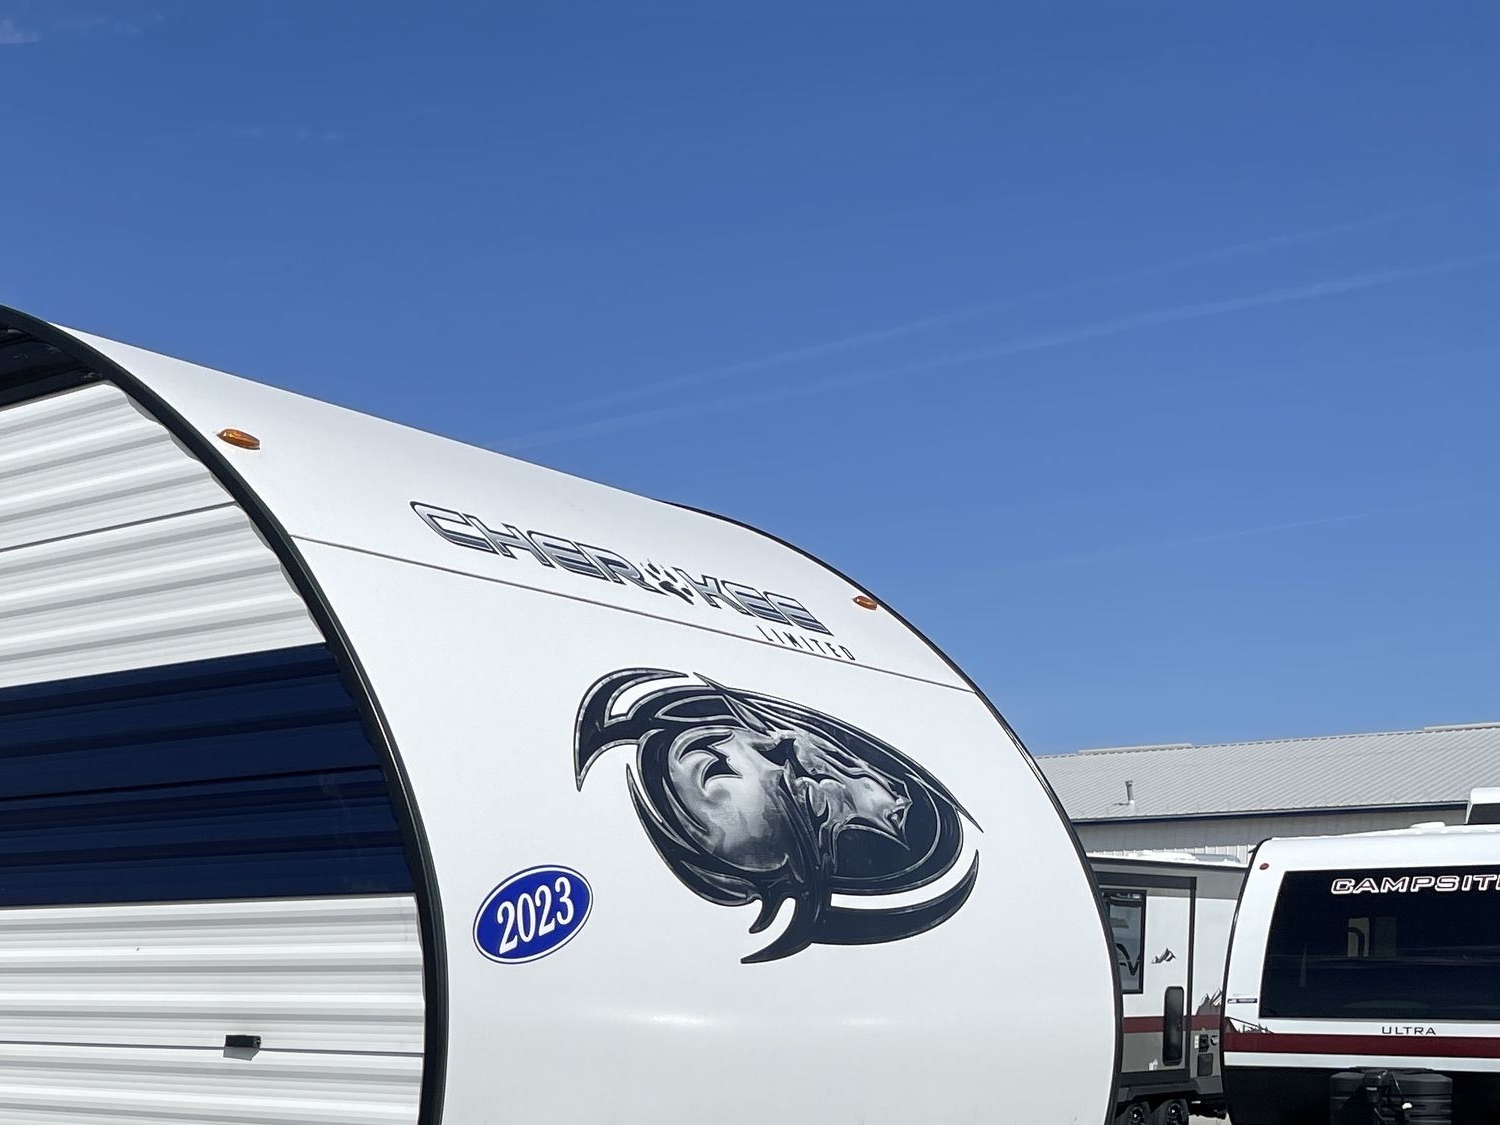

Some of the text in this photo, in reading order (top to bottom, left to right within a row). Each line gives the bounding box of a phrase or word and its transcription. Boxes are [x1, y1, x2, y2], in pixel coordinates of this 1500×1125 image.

[756, 625, 857, 662] LIMITED
[1330, 875, 1500, 895] CAMPSIT
[497, 876, 574, 954] 2023
[1381, 1026, 1436, 1036] ULTRA
